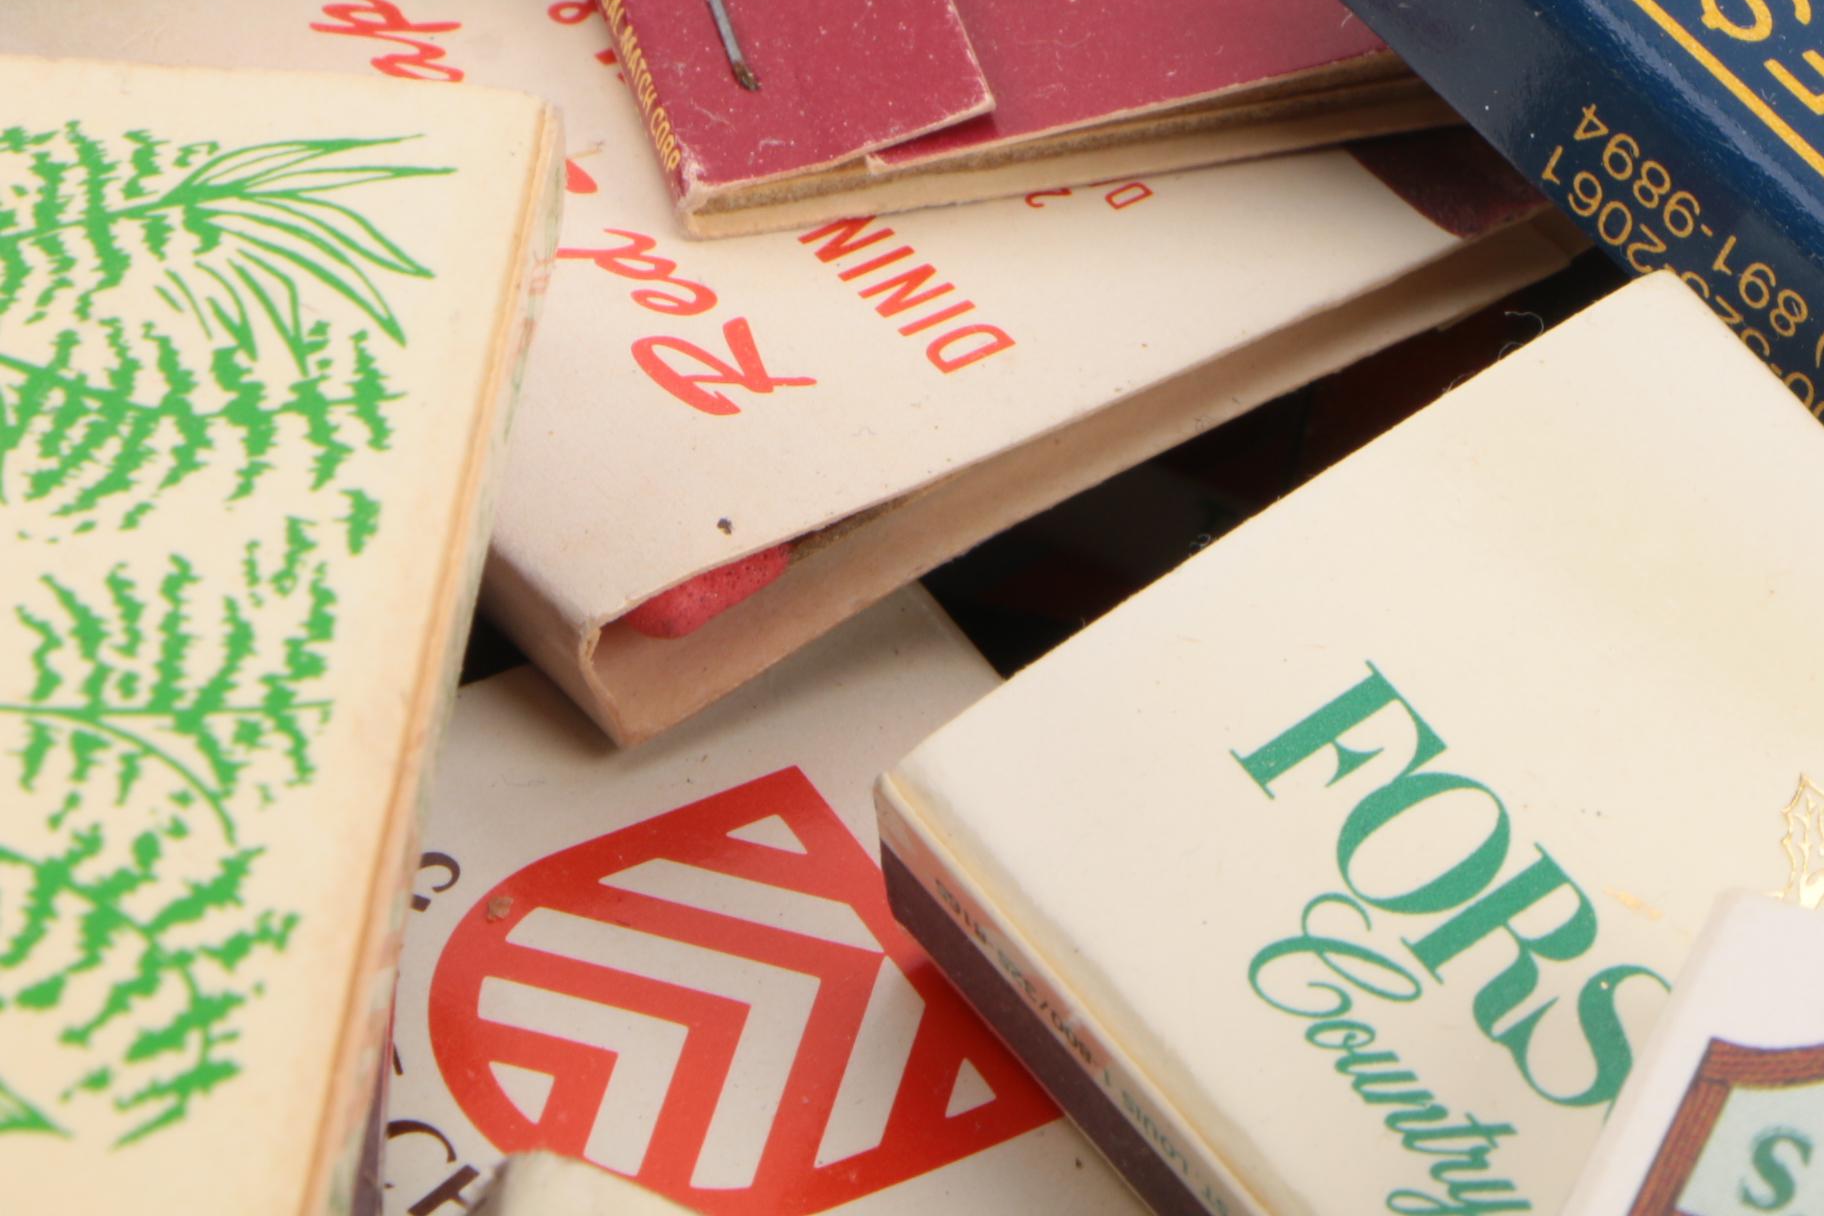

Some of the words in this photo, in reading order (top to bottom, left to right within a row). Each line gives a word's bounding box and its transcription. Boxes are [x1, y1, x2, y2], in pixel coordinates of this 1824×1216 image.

[620, 23, 657, 106] MATCH
[644, 106, 681, 172] CORP
[798, 216, 1016, 374] DININ
[1572, 103, 1808, 337] 891-9894
[556, 229, 817, 416] Red
